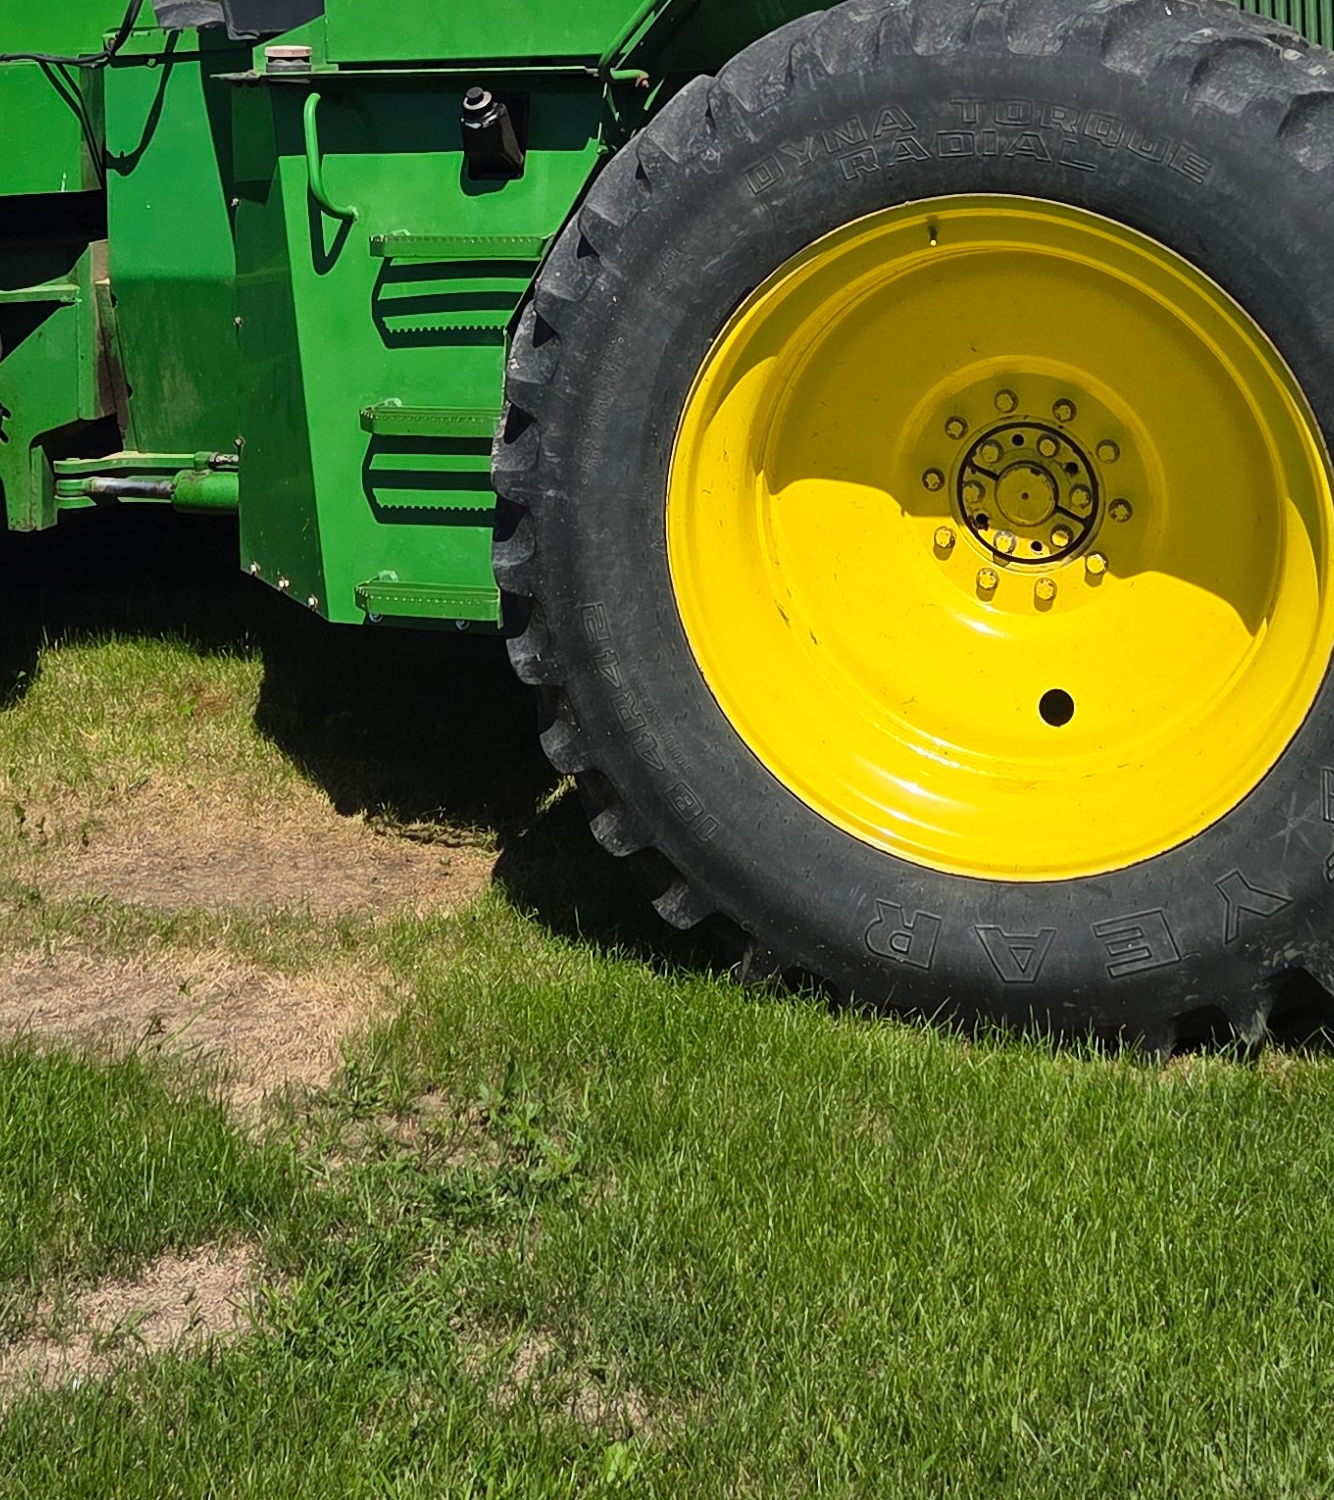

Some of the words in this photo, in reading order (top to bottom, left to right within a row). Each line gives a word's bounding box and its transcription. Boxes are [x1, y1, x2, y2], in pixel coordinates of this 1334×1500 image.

[740, 103, 917, 196] DYNA
[949, 95, 1214, 185] TORQUE
[838, 128, 1098, 182] RADIAL
